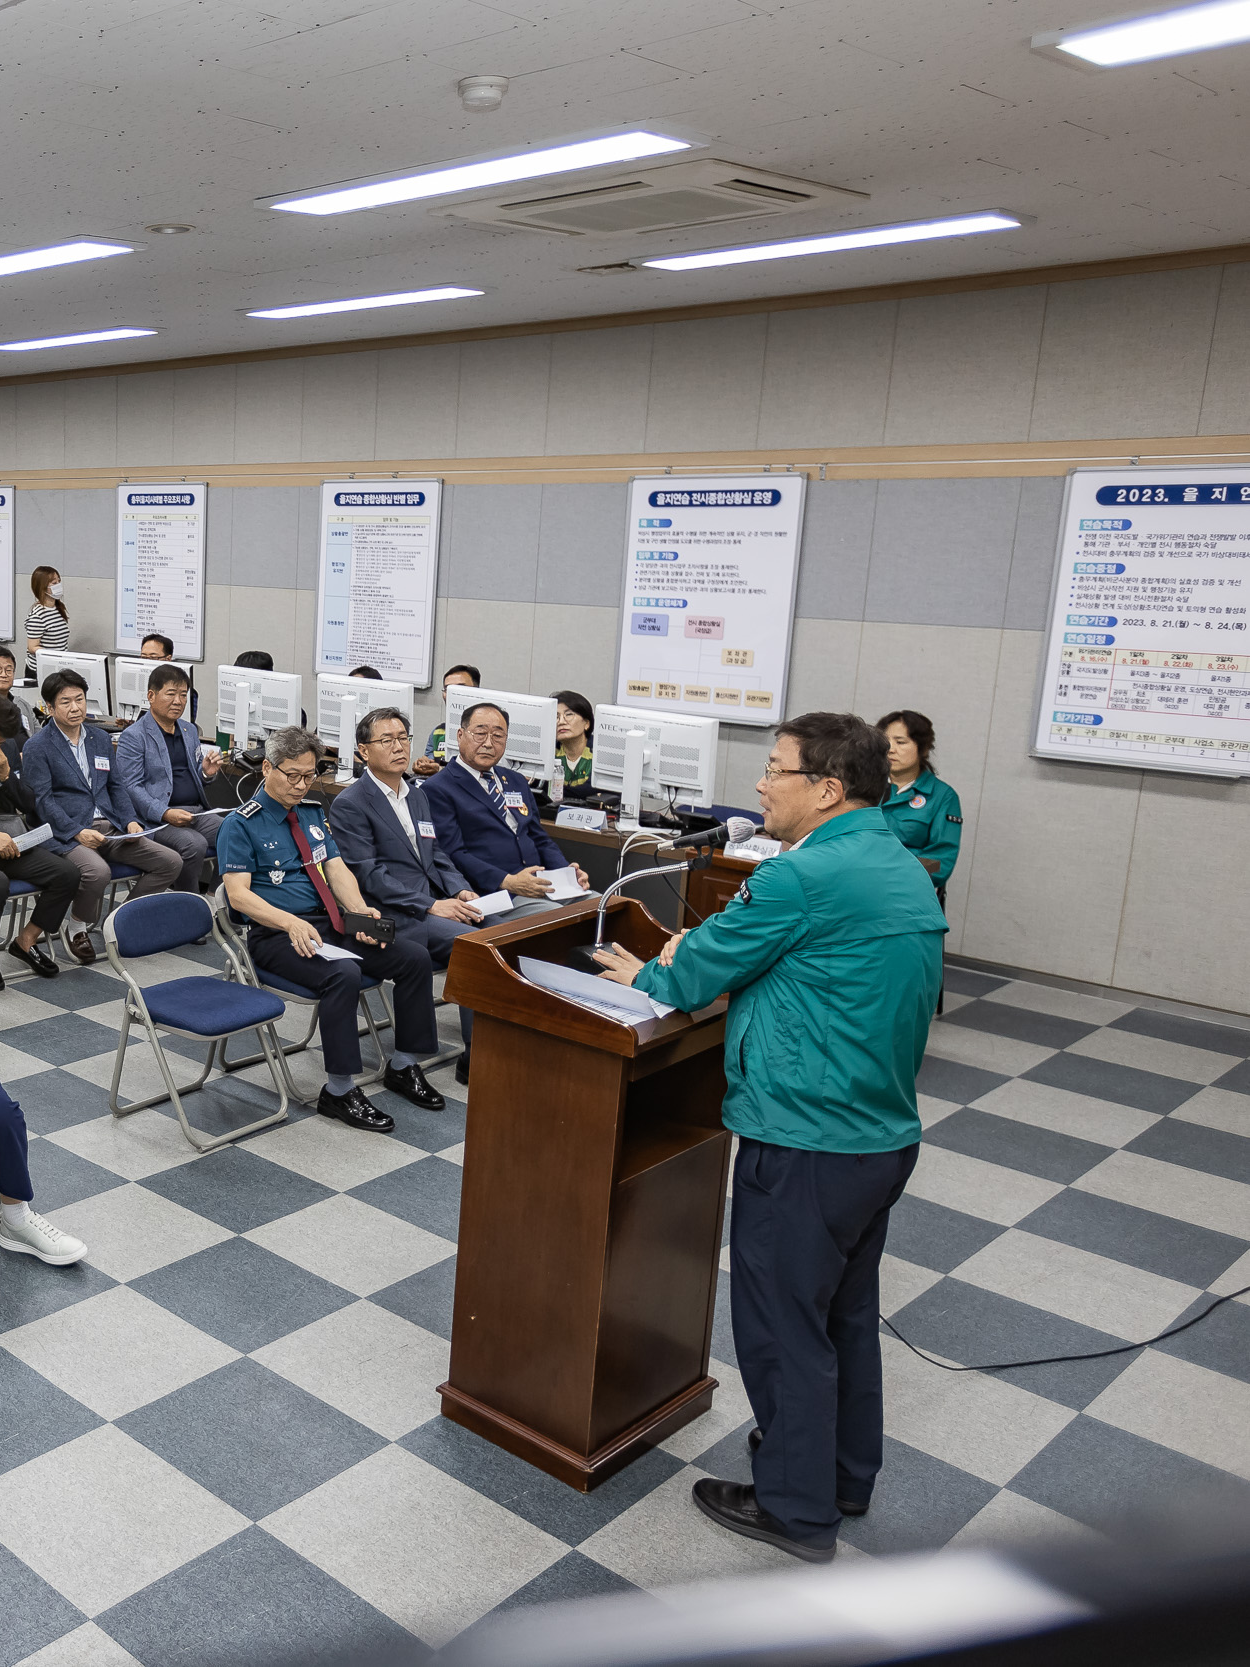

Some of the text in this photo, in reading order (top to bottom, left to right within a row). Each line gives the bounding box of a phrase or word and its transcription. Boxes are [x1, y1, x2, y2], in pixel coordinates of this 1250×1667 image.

[339, 494, 363, 504] 을지연습
[363, 494, 392, 504] 종합상황실
[406, 494, 420, 504] 임무
[656, 491, 772, 506] 을지연습 전시종합상황실 운영
[1116, 488, 1169, 503] 2023.
[1082, 520, 1123, 530] 연습목적
[1113, 533, 1138, 541] 국지도발
[1146, 533, 1185, 541] 국가위기관리
[1187, 533, 1207, 541] 연습과
[1117, 541, 1130, 549] 부서
[1158, 541, 1172, 549] 전시
[1166, 551, 1193, 559] 개선으로
[1195, 551, 1209, 559] 국가
[1076, 563, 1117, 573] 연습중점
[1201, 578, 1215, 586] 검증
[1227, 579, 1242, 587] 개선
[1185, 605, 1207, 613] 토의형
[1209, 606, 1223, 614] 연습
[1225, 606, 1247, 615] 활성화
[1069, 615, 1109, 626] 연습기간
[1122, 618, 1146, 627] 2023.
[1150, 619, 1158, 627] 8.
[1162, 619, 1190, 628] 21.(월)
[1204, 621, 1213, 630] 8.
[1217, 622, 1247, 631] 24.(목)
[1066, 633, 1106, 644] 연습일정
[1216, 663, 1239, 671] 23.(수)
[320, 690, 335, 698] ATEC
[1055, 712, 1095, 724] 참가기관
[599, 723, 616, 732] ATEC
[1164, 736, 1185, 744] 군부대
[1194, 739, 1214, 747] 사업소
[1220, 741, 1248, 750] 유관기관
[566, 813, 593, 824] 보좌관
